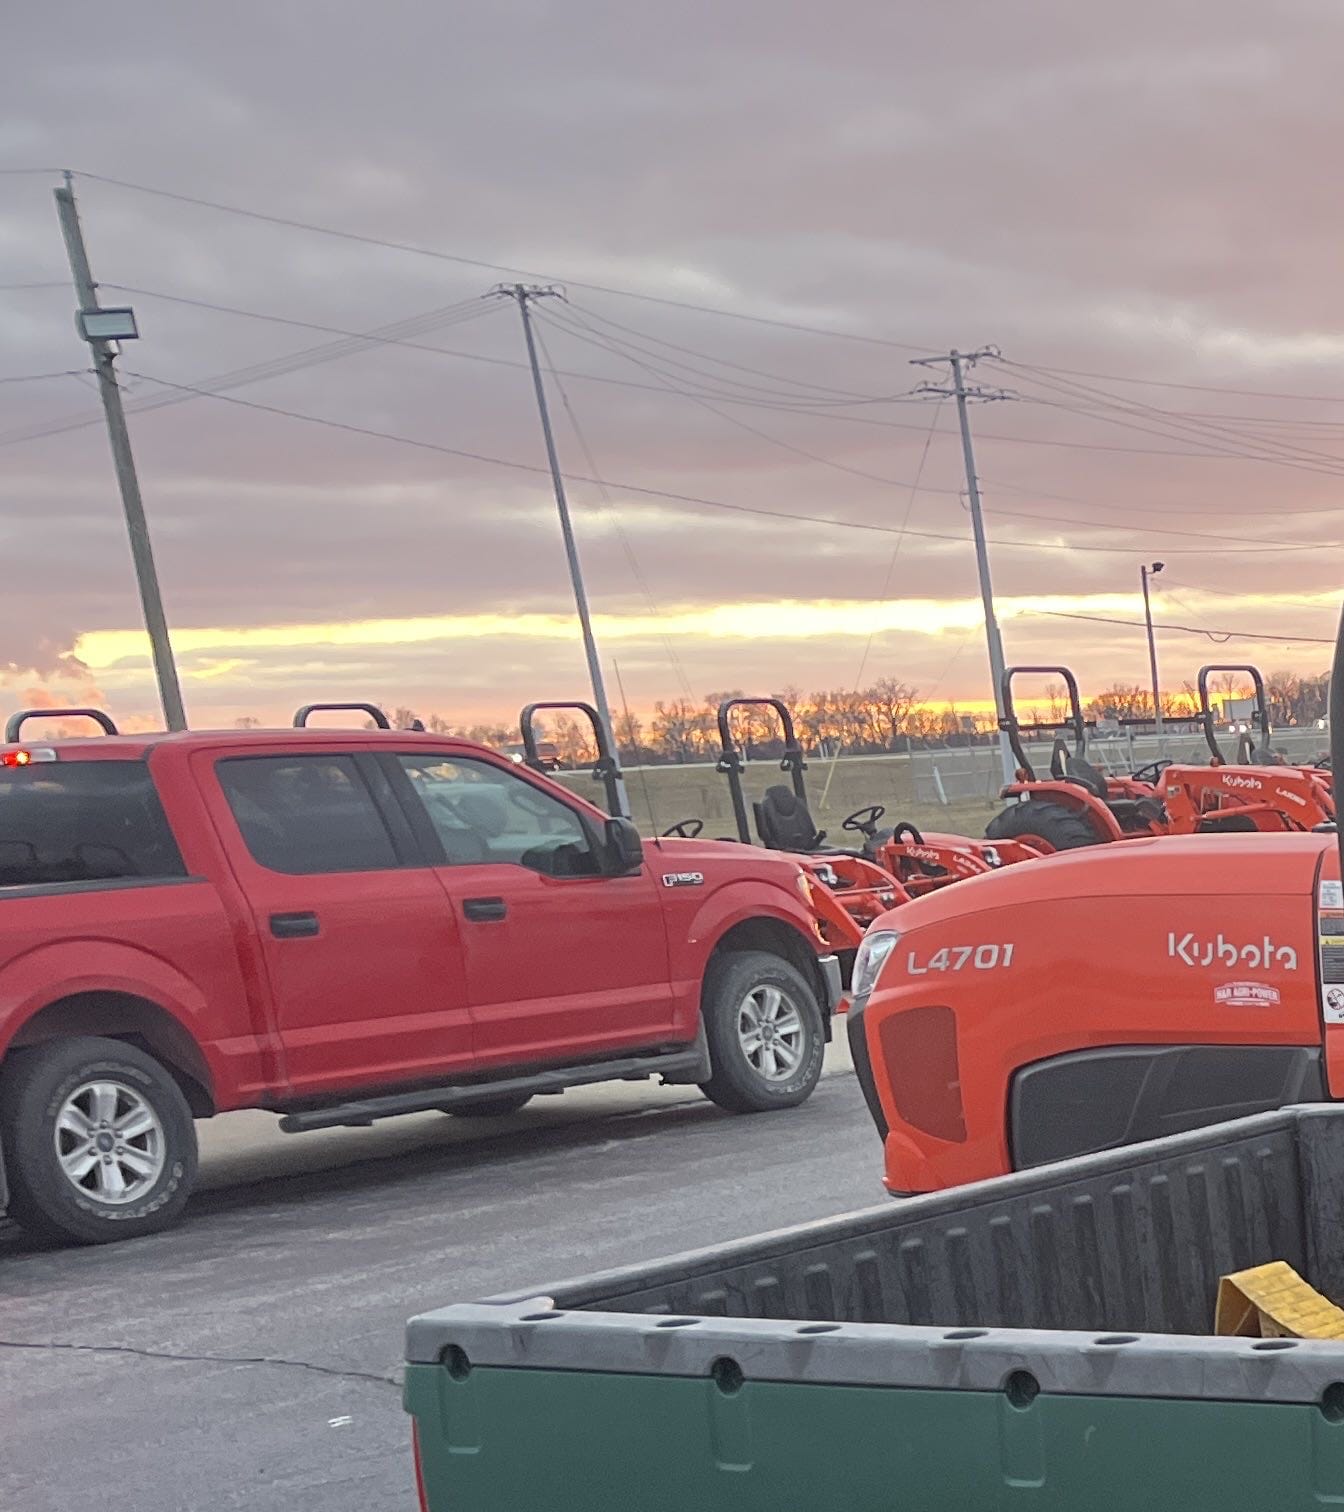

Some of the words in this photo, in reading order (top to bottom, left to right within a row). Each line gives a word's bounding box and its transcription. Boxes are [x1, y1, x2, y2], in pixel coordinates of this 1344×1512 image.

[1222, 773, 1263, 790] Kubota
[907, 944, 1014, 976] L4701
[1168, 932, 1297, 971] Kubota
